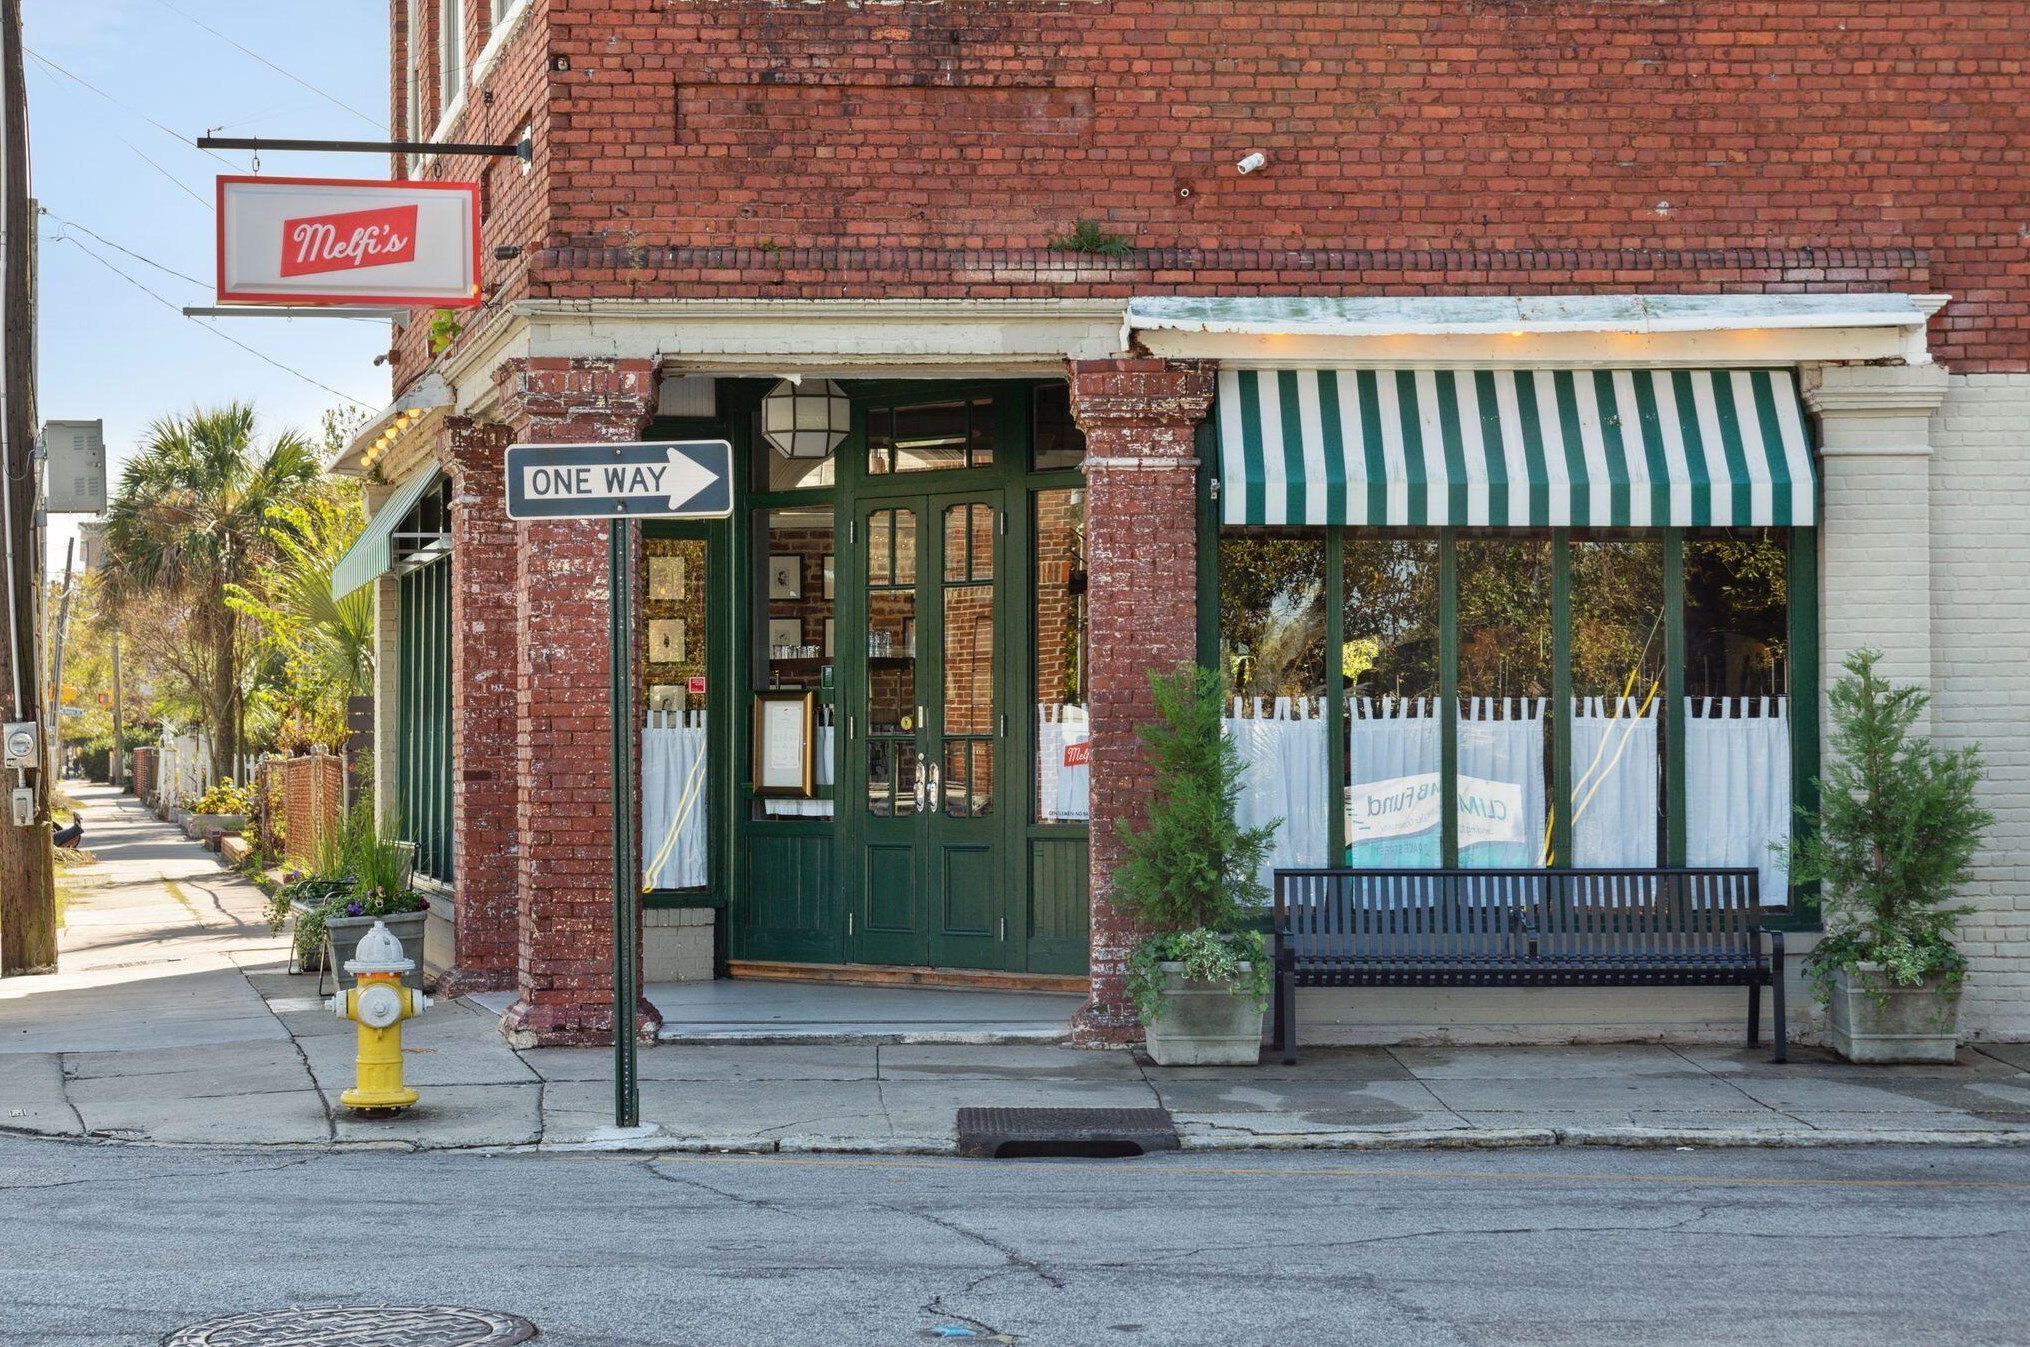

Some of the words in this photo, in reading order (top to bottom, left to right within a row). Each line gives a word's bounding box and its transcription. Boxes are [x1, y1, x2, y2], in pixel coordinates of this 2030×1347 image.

[293, 223, 408, 265] Melfi's
[532, 468, 592, 495] ONE
[604, 465, 668, 494] WAY
